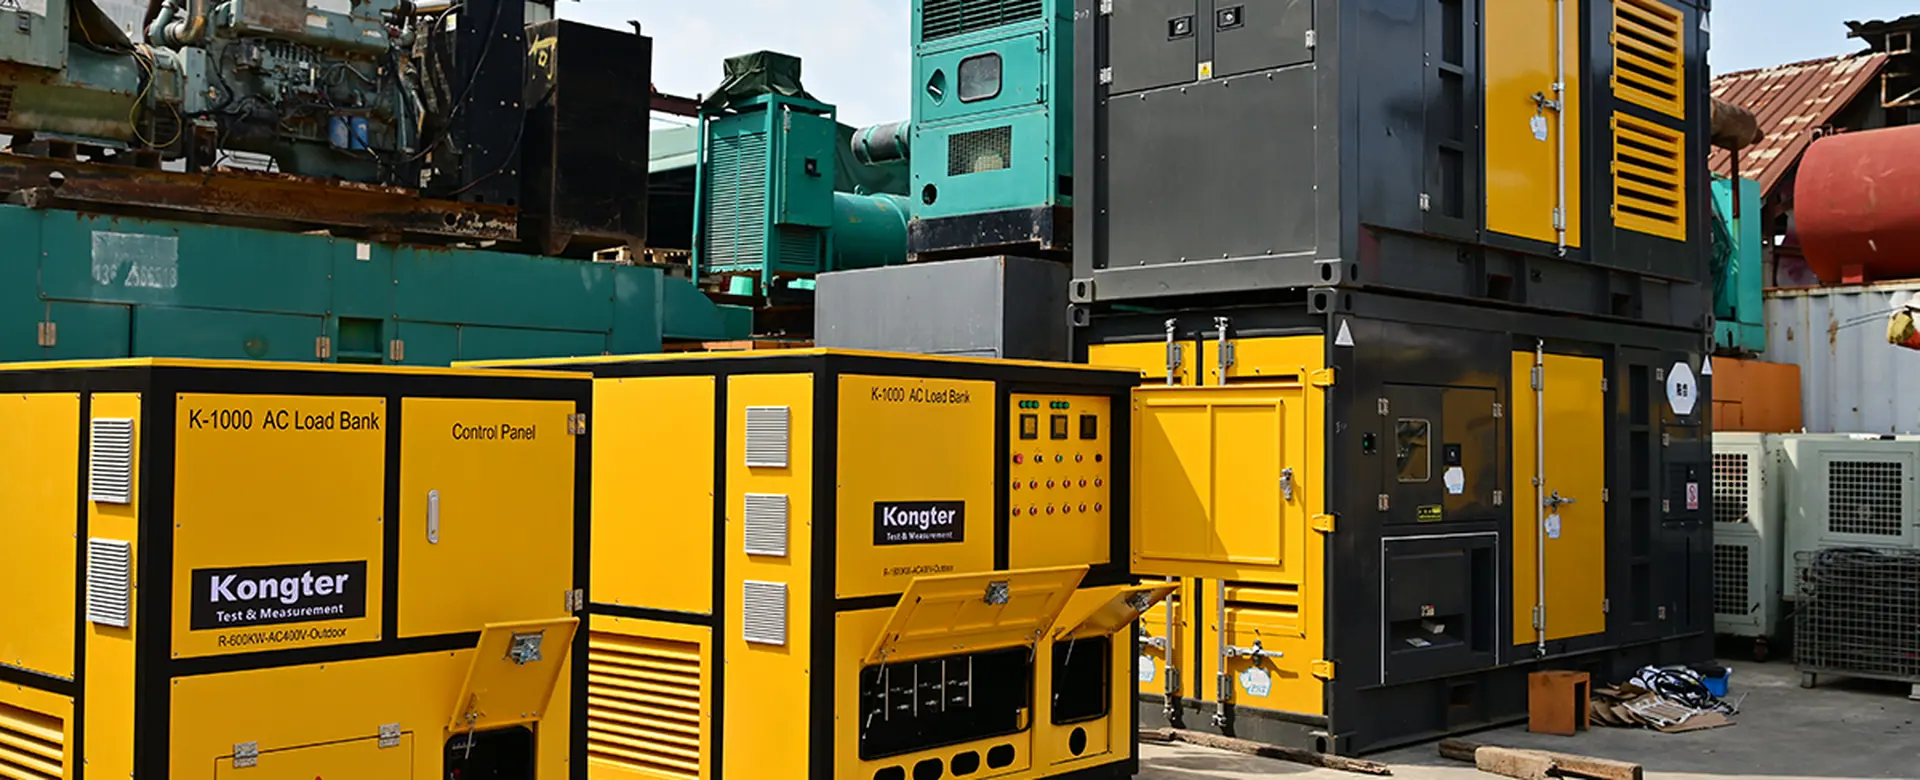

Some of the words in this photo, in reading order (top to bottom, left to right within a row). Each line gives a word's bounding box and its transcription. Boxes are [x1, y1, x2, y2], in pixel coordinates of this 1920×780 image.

[871, 386, 905, 402] K-1000
[909, 388, 923, 403] AC
[925, 388, 947, 404] Load
[948, 388, 971, 404] Bank
[188, 408, 253, 430] K-1000
[262, 410, 289, 430] AC
[294, 411, 335, 430] Load
[340, 411, 380, 430] Bank
[452, 422, 498, 440] Control
[501, 423, 536, 440] Panel
[883, 506, 956, 530] Kongter
[210, 570, 350, 604] Kongter
[216, 611, 243, 623] Test
[245, 609, 257, 621] &
[260, 604, 344, 619] Measurement
